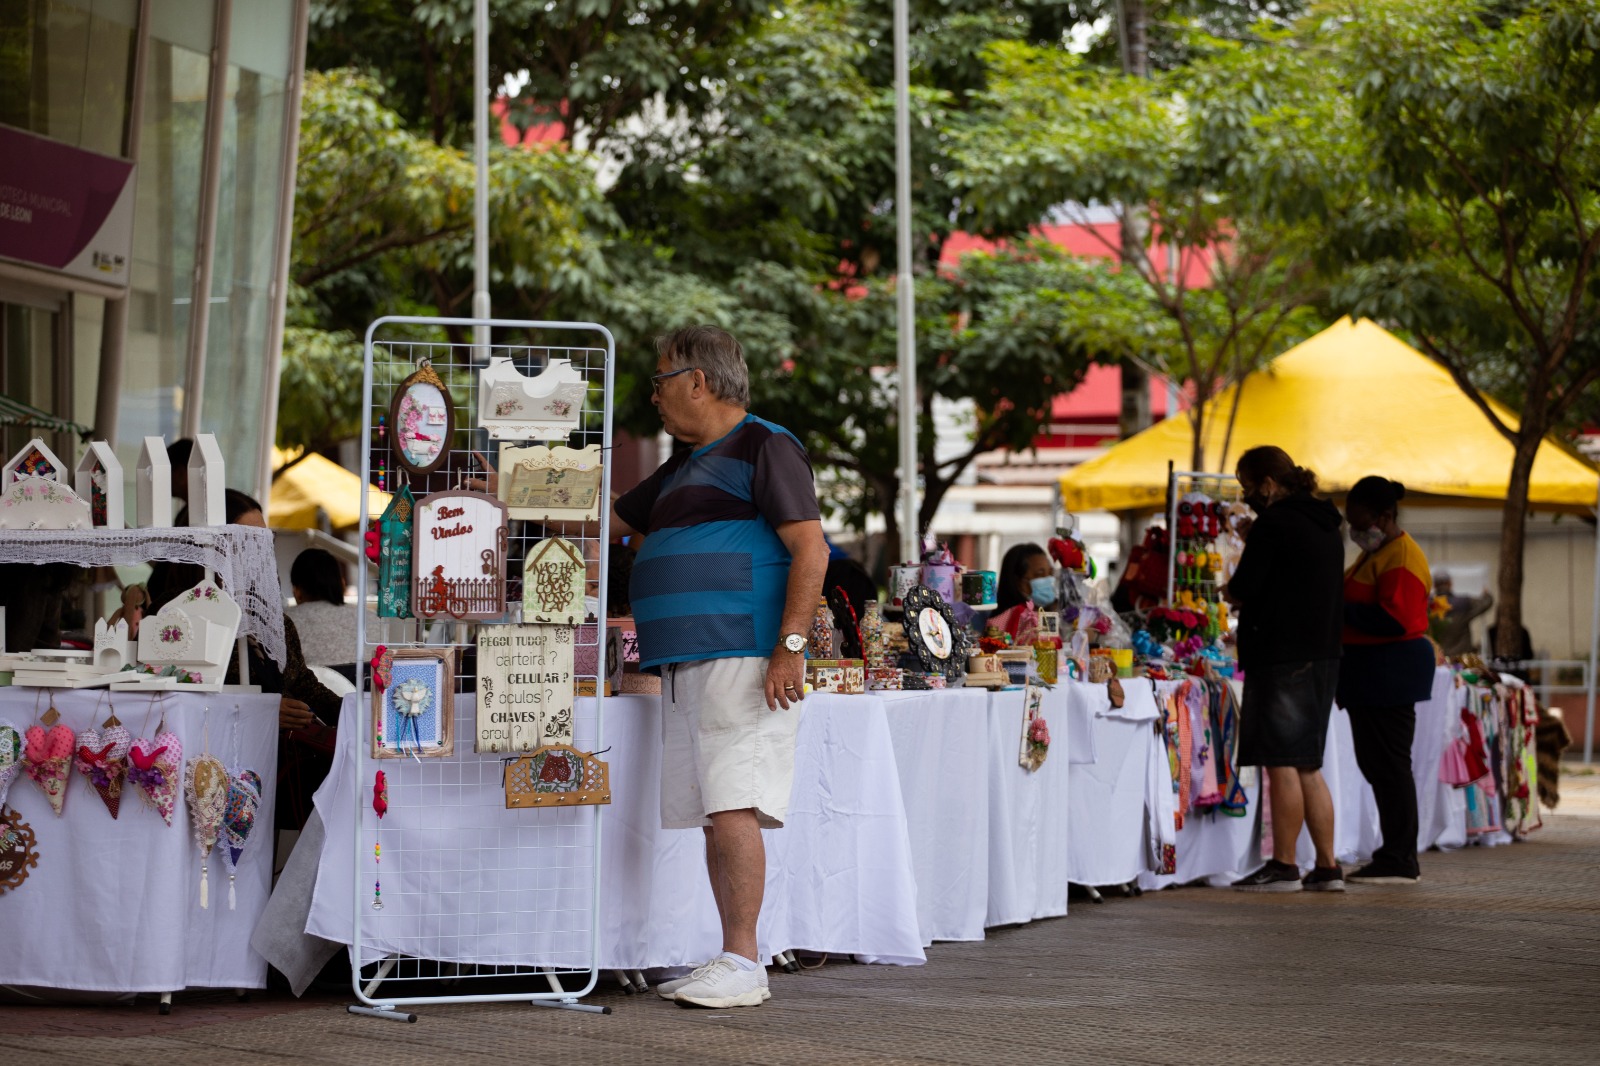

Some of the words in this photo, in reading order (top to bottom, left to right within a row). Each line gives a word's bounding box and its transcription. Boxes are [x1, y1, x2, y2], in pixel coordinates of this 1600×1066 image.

[437, 506, 465, 520] Bem
[431, 522, 473, 540] Vindos
[536, 572, 573, 586] LUGAR
[536, 582, 571, 594] COMO
[537, 591, 575, 607] NOSSO
[480, 636, 512, 647] PEGOU
[516, 635, 548, 646] TUDO?
[496, 651, 546, 667] carteira
[507, 672, 560, 684] CELULAR
[499, 690, 542, 705] óculos
[490, 712, 536, 723] CHAVES
[481, 729, 510, 740] orou
